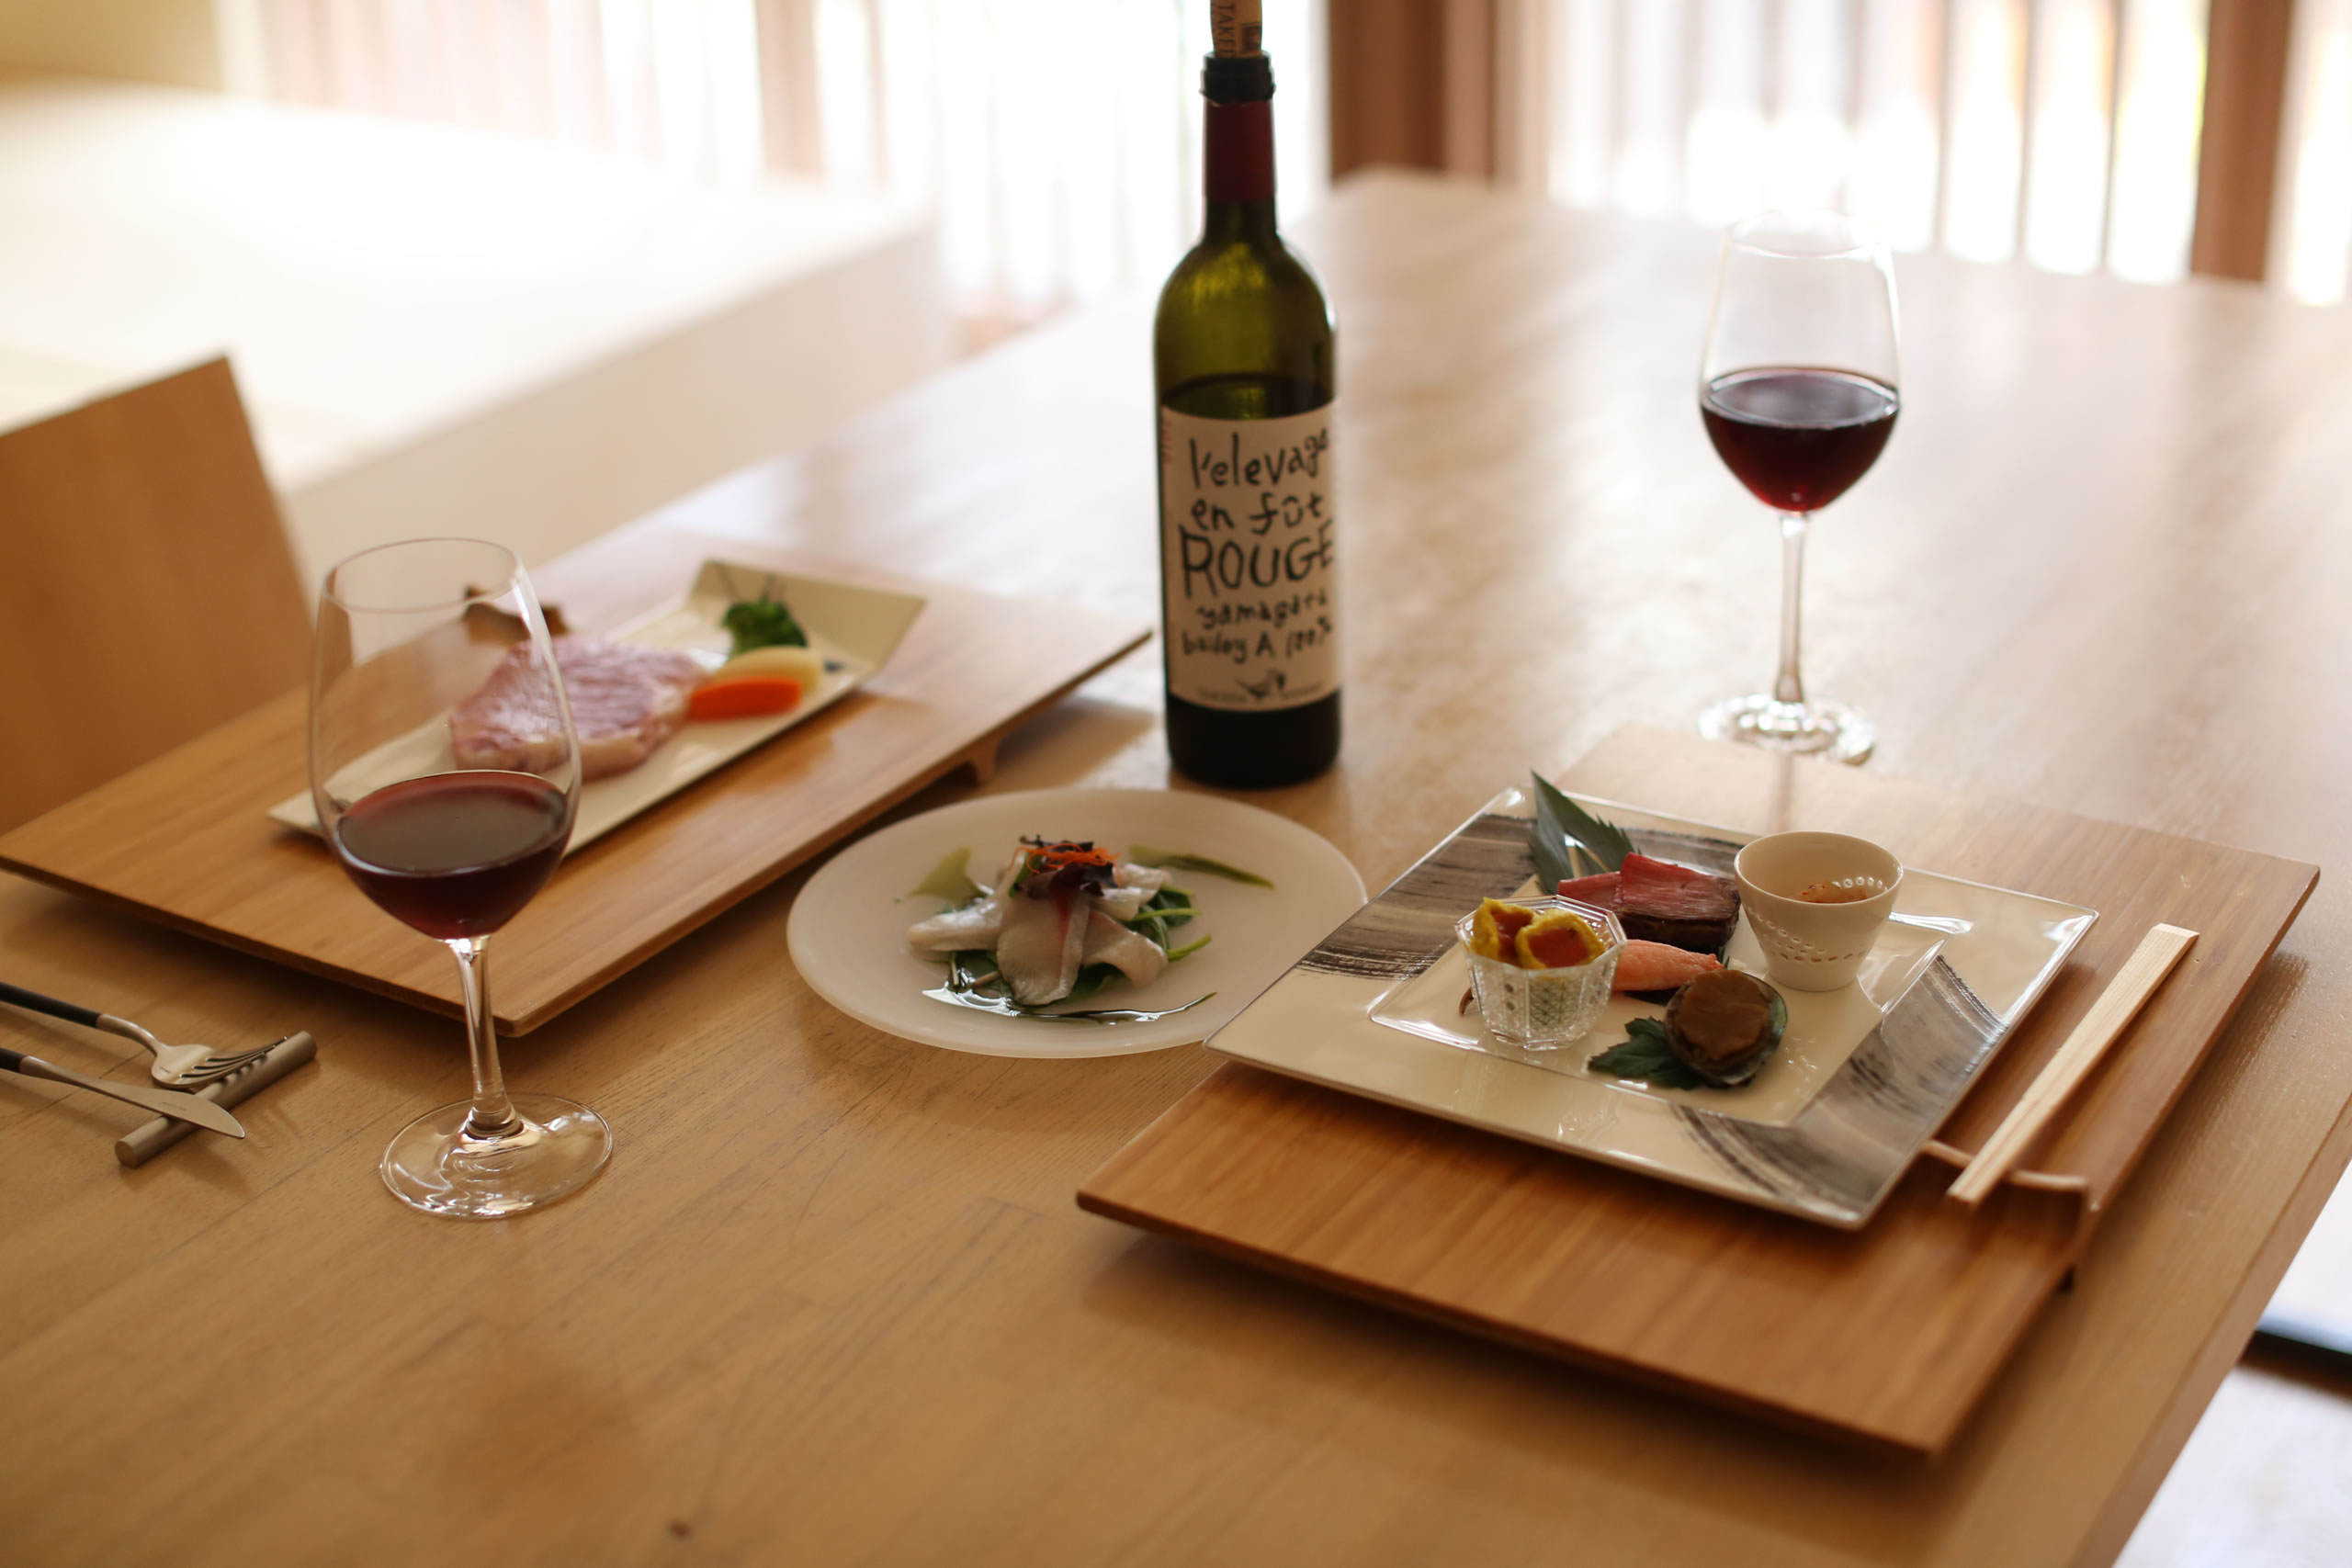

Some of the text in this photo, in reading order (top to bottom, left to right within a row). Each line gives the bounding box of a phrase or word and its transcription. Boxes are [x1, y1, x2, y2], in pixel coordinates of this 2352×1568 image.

[1191, 497, 1235, 531] en
[1178, 518, 1335, 599] ROUGE
[1255, 631, 1275, 659] A
